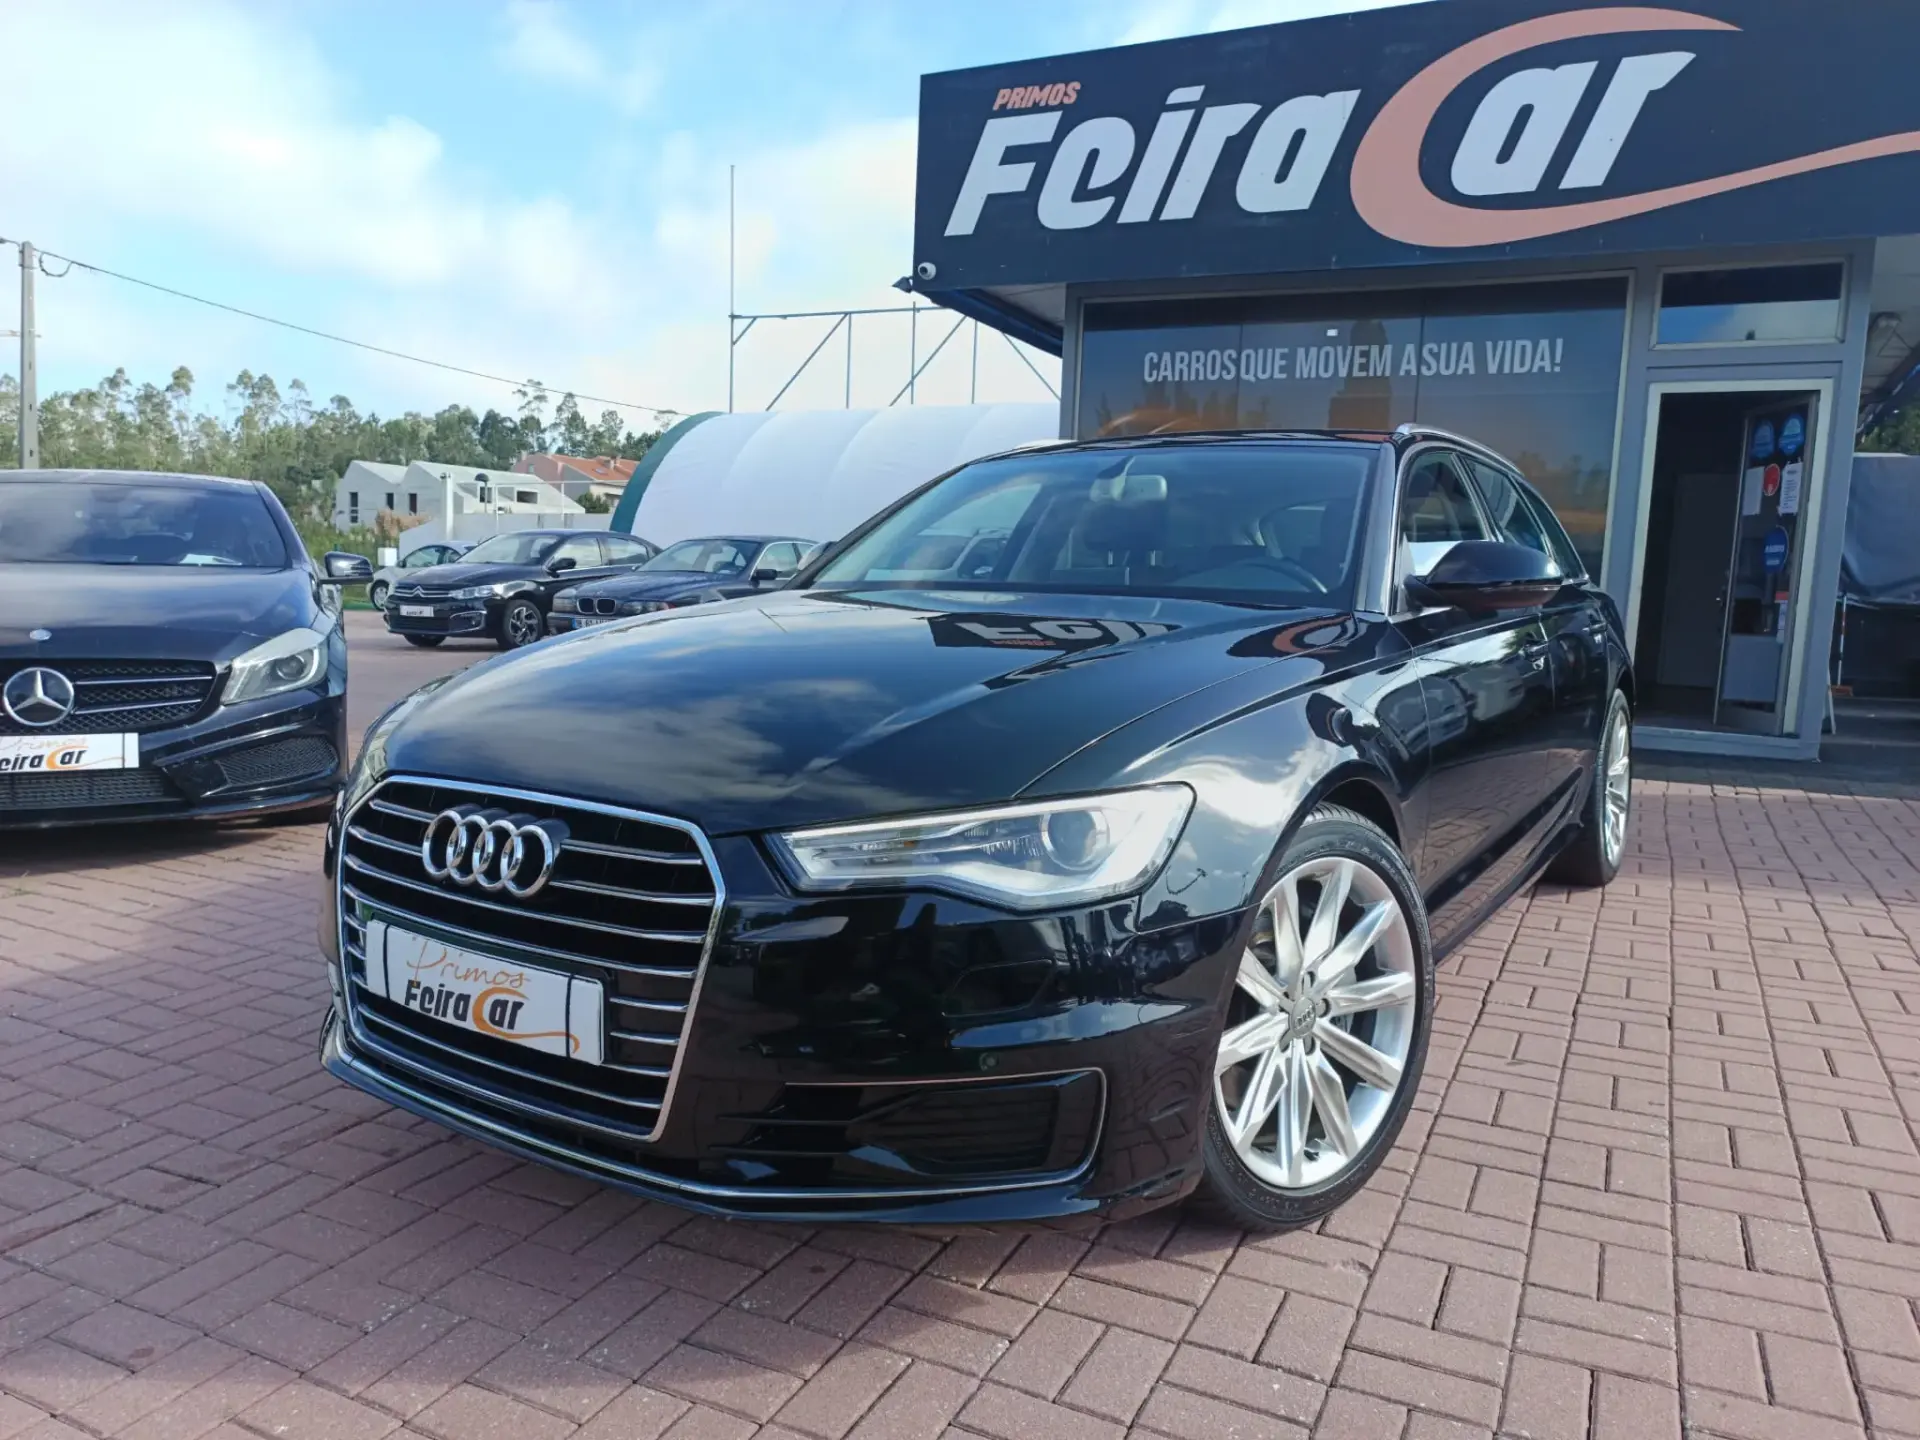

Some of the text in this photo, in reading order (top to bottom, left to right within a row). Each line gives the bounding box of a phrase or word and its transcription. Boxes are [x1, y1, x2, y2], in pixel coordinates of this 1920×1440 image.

[992, 81, 1081, 111] PRIMOS
[1143, 338, 1565, 383] CARROS QUE MOVEM A SUA VIDA!
[0, 744, 89, 771] eiraCar
[405, 939, 532, 988] Primos
